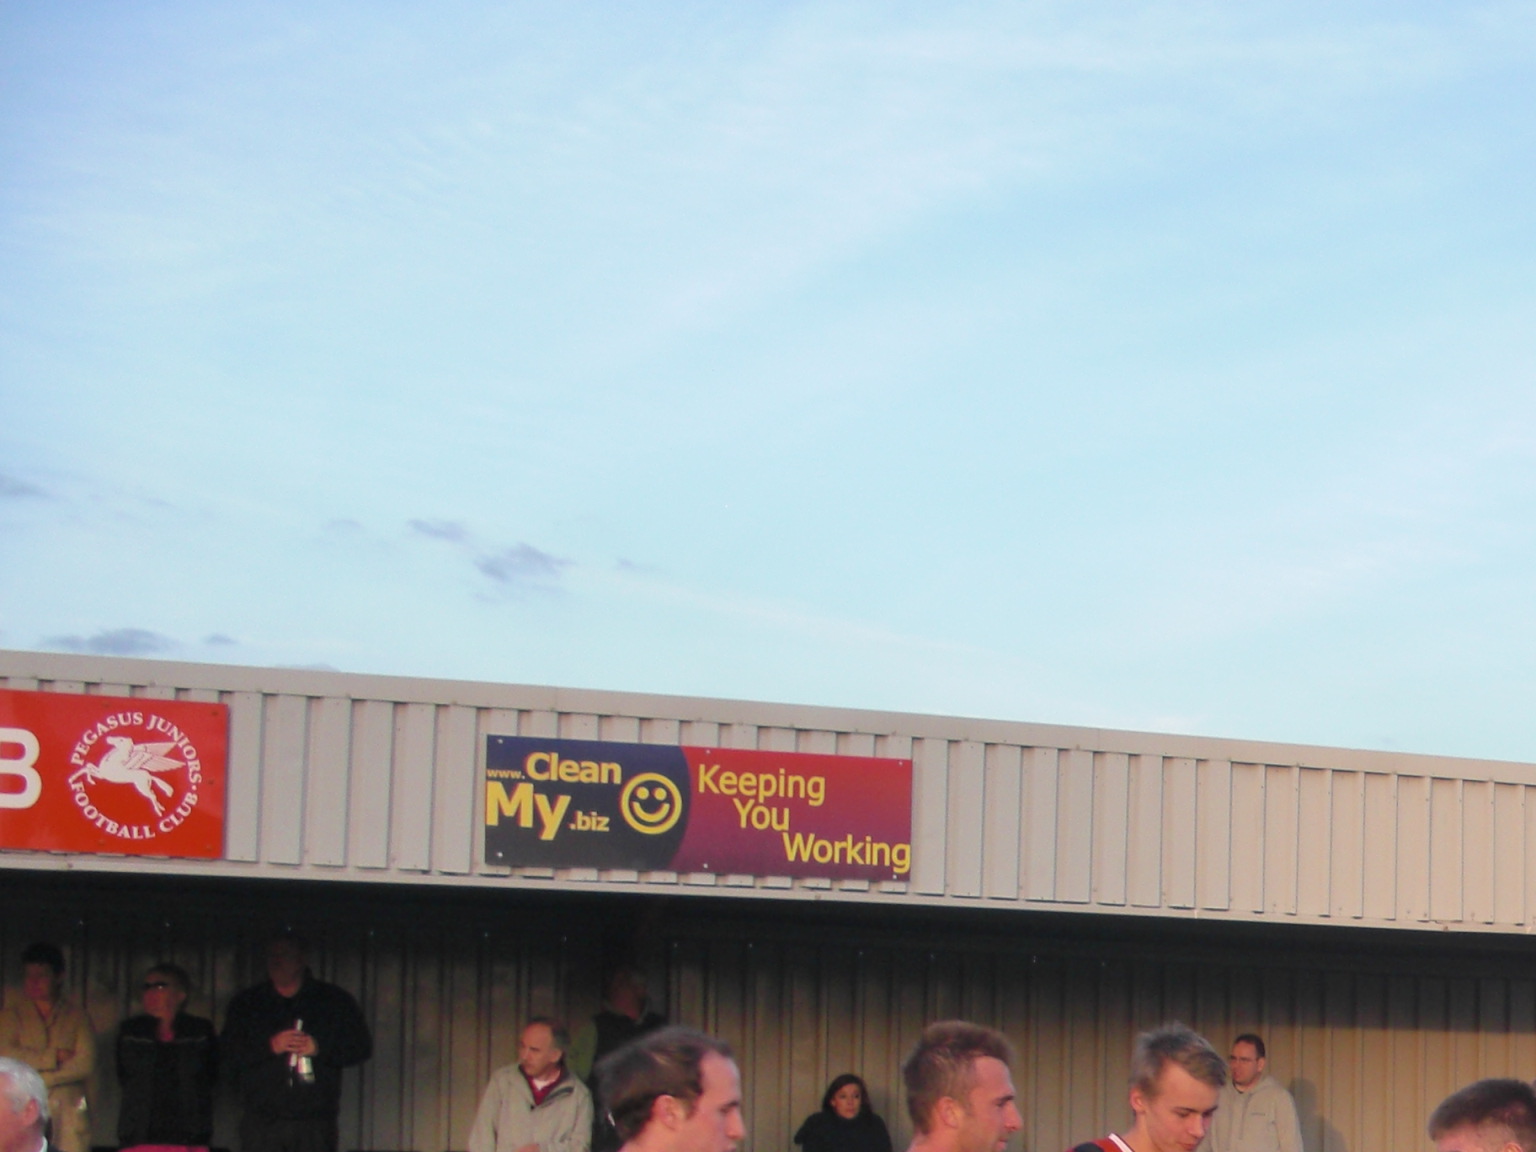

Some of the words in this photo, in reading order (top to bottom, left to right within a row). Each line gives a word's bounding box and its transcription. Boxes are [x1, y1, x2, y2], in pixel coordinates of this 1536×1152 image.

[71, 712, 143, 765] PEGASUS
[147, 714, 202, 784] JUNIORS
[698, 764, 825, 806] Keeping
[71, 781, 155, 839] FOOTBALL
[159, 792, 198, 832] CLUB
[733, 798, 789, 830] You
[782, 832, 911, 873] Working
